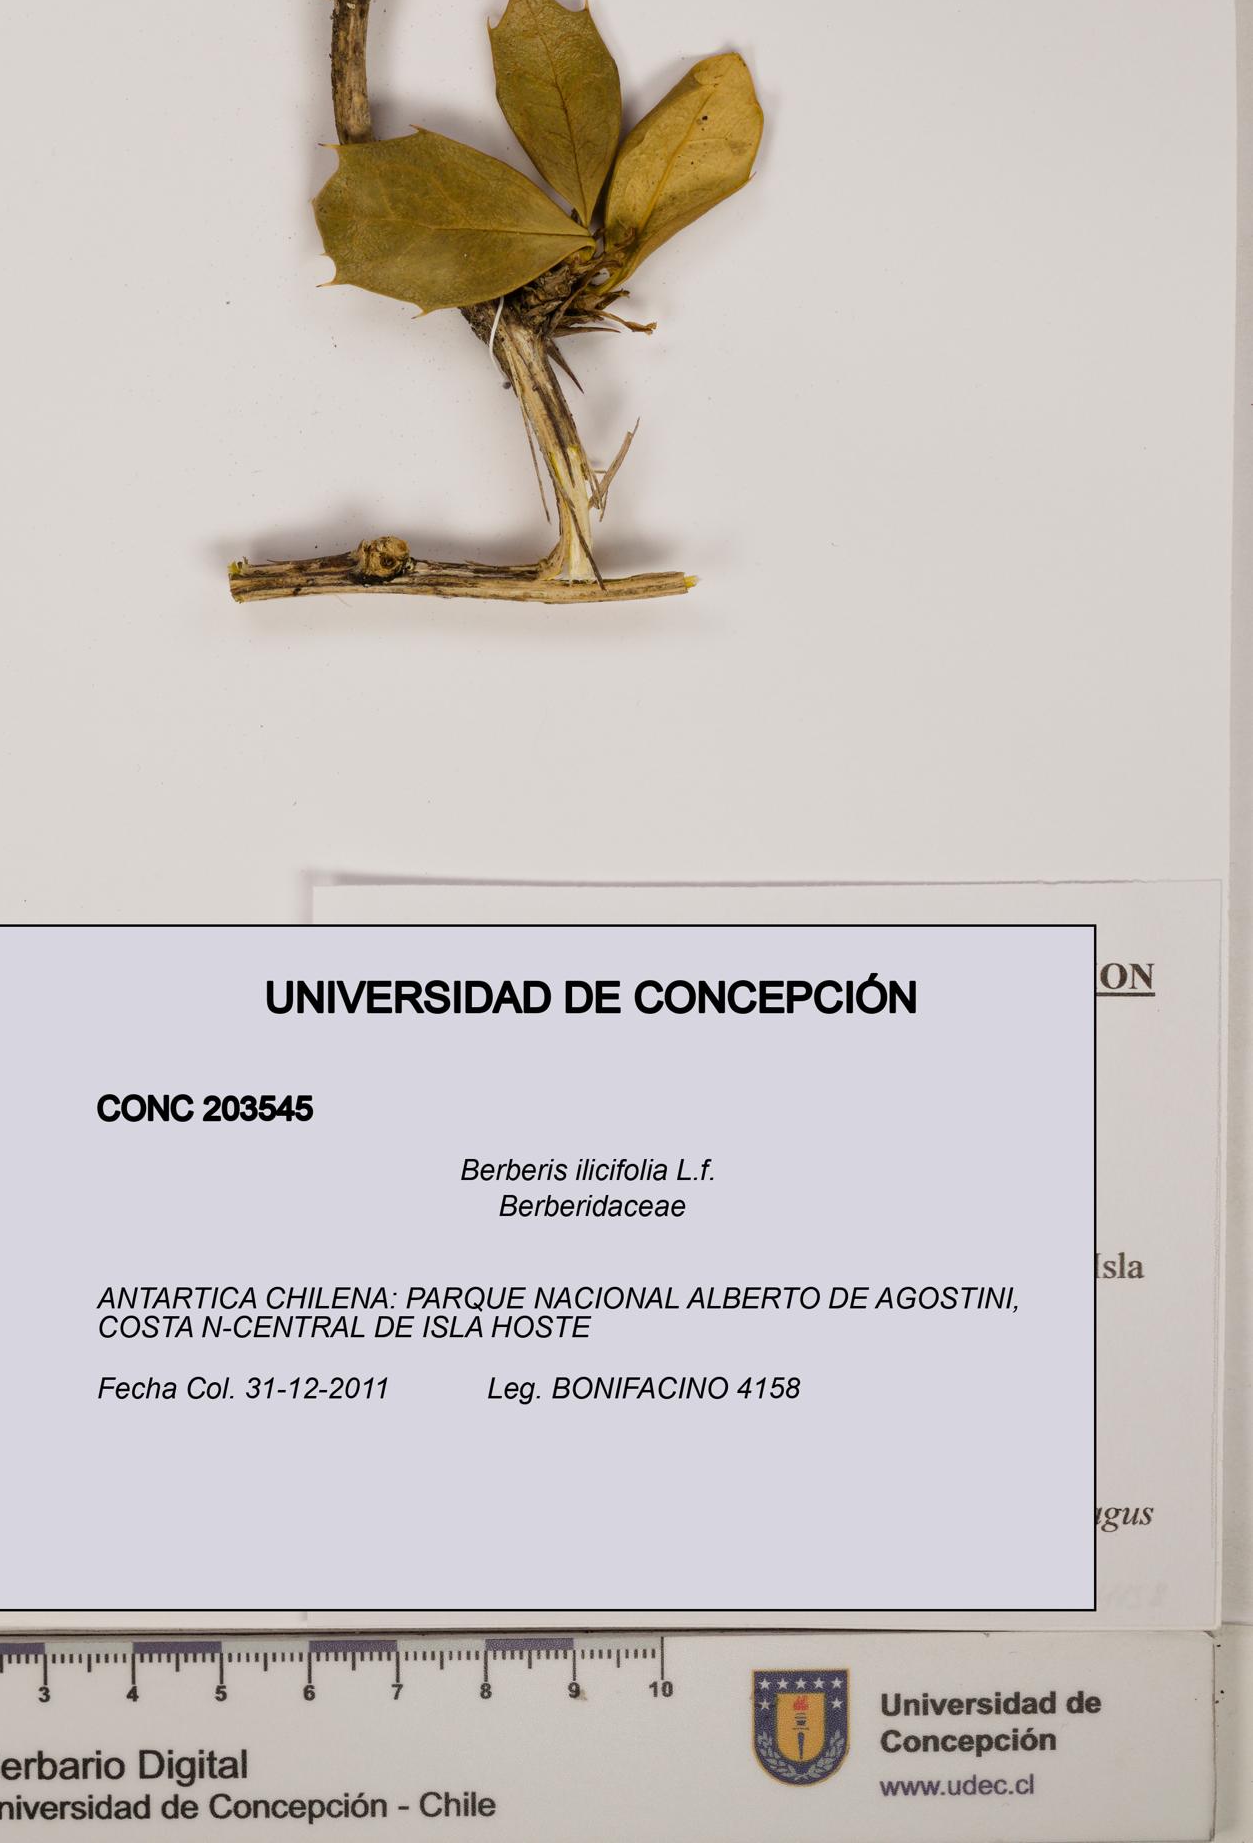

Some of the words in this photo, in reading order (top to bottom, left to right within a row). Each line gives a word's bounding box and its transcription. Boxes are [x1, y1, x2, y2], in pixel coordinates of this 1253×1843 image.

[37, 1687, 51, 1704] 3
[125, 1686, 140, 1703] 4
[214, 1686, 228, 1703] 5
[302, 1685, 316, 1702] 6
[391, 1684, 404, 1701] 7
[479, 1684, 493, 1700] 8
[567, 1683, 580, 1700] 9
[648, 1681, 674, 1698] 10
[881, 1690, 1057, 1717] Universidad
[1065, 1690, 1102, 1715] de
[879, 1726, 1057, 1759] Concepción
[138, 1748, 248, 1785] Digital
[879, 1773, 1035, 1797] www.udec.cl
[160, 1793, 200, 1820] de
[208, 1792, 388, 1825] Concepción
[419, 1791, 497, 1818] Chile
